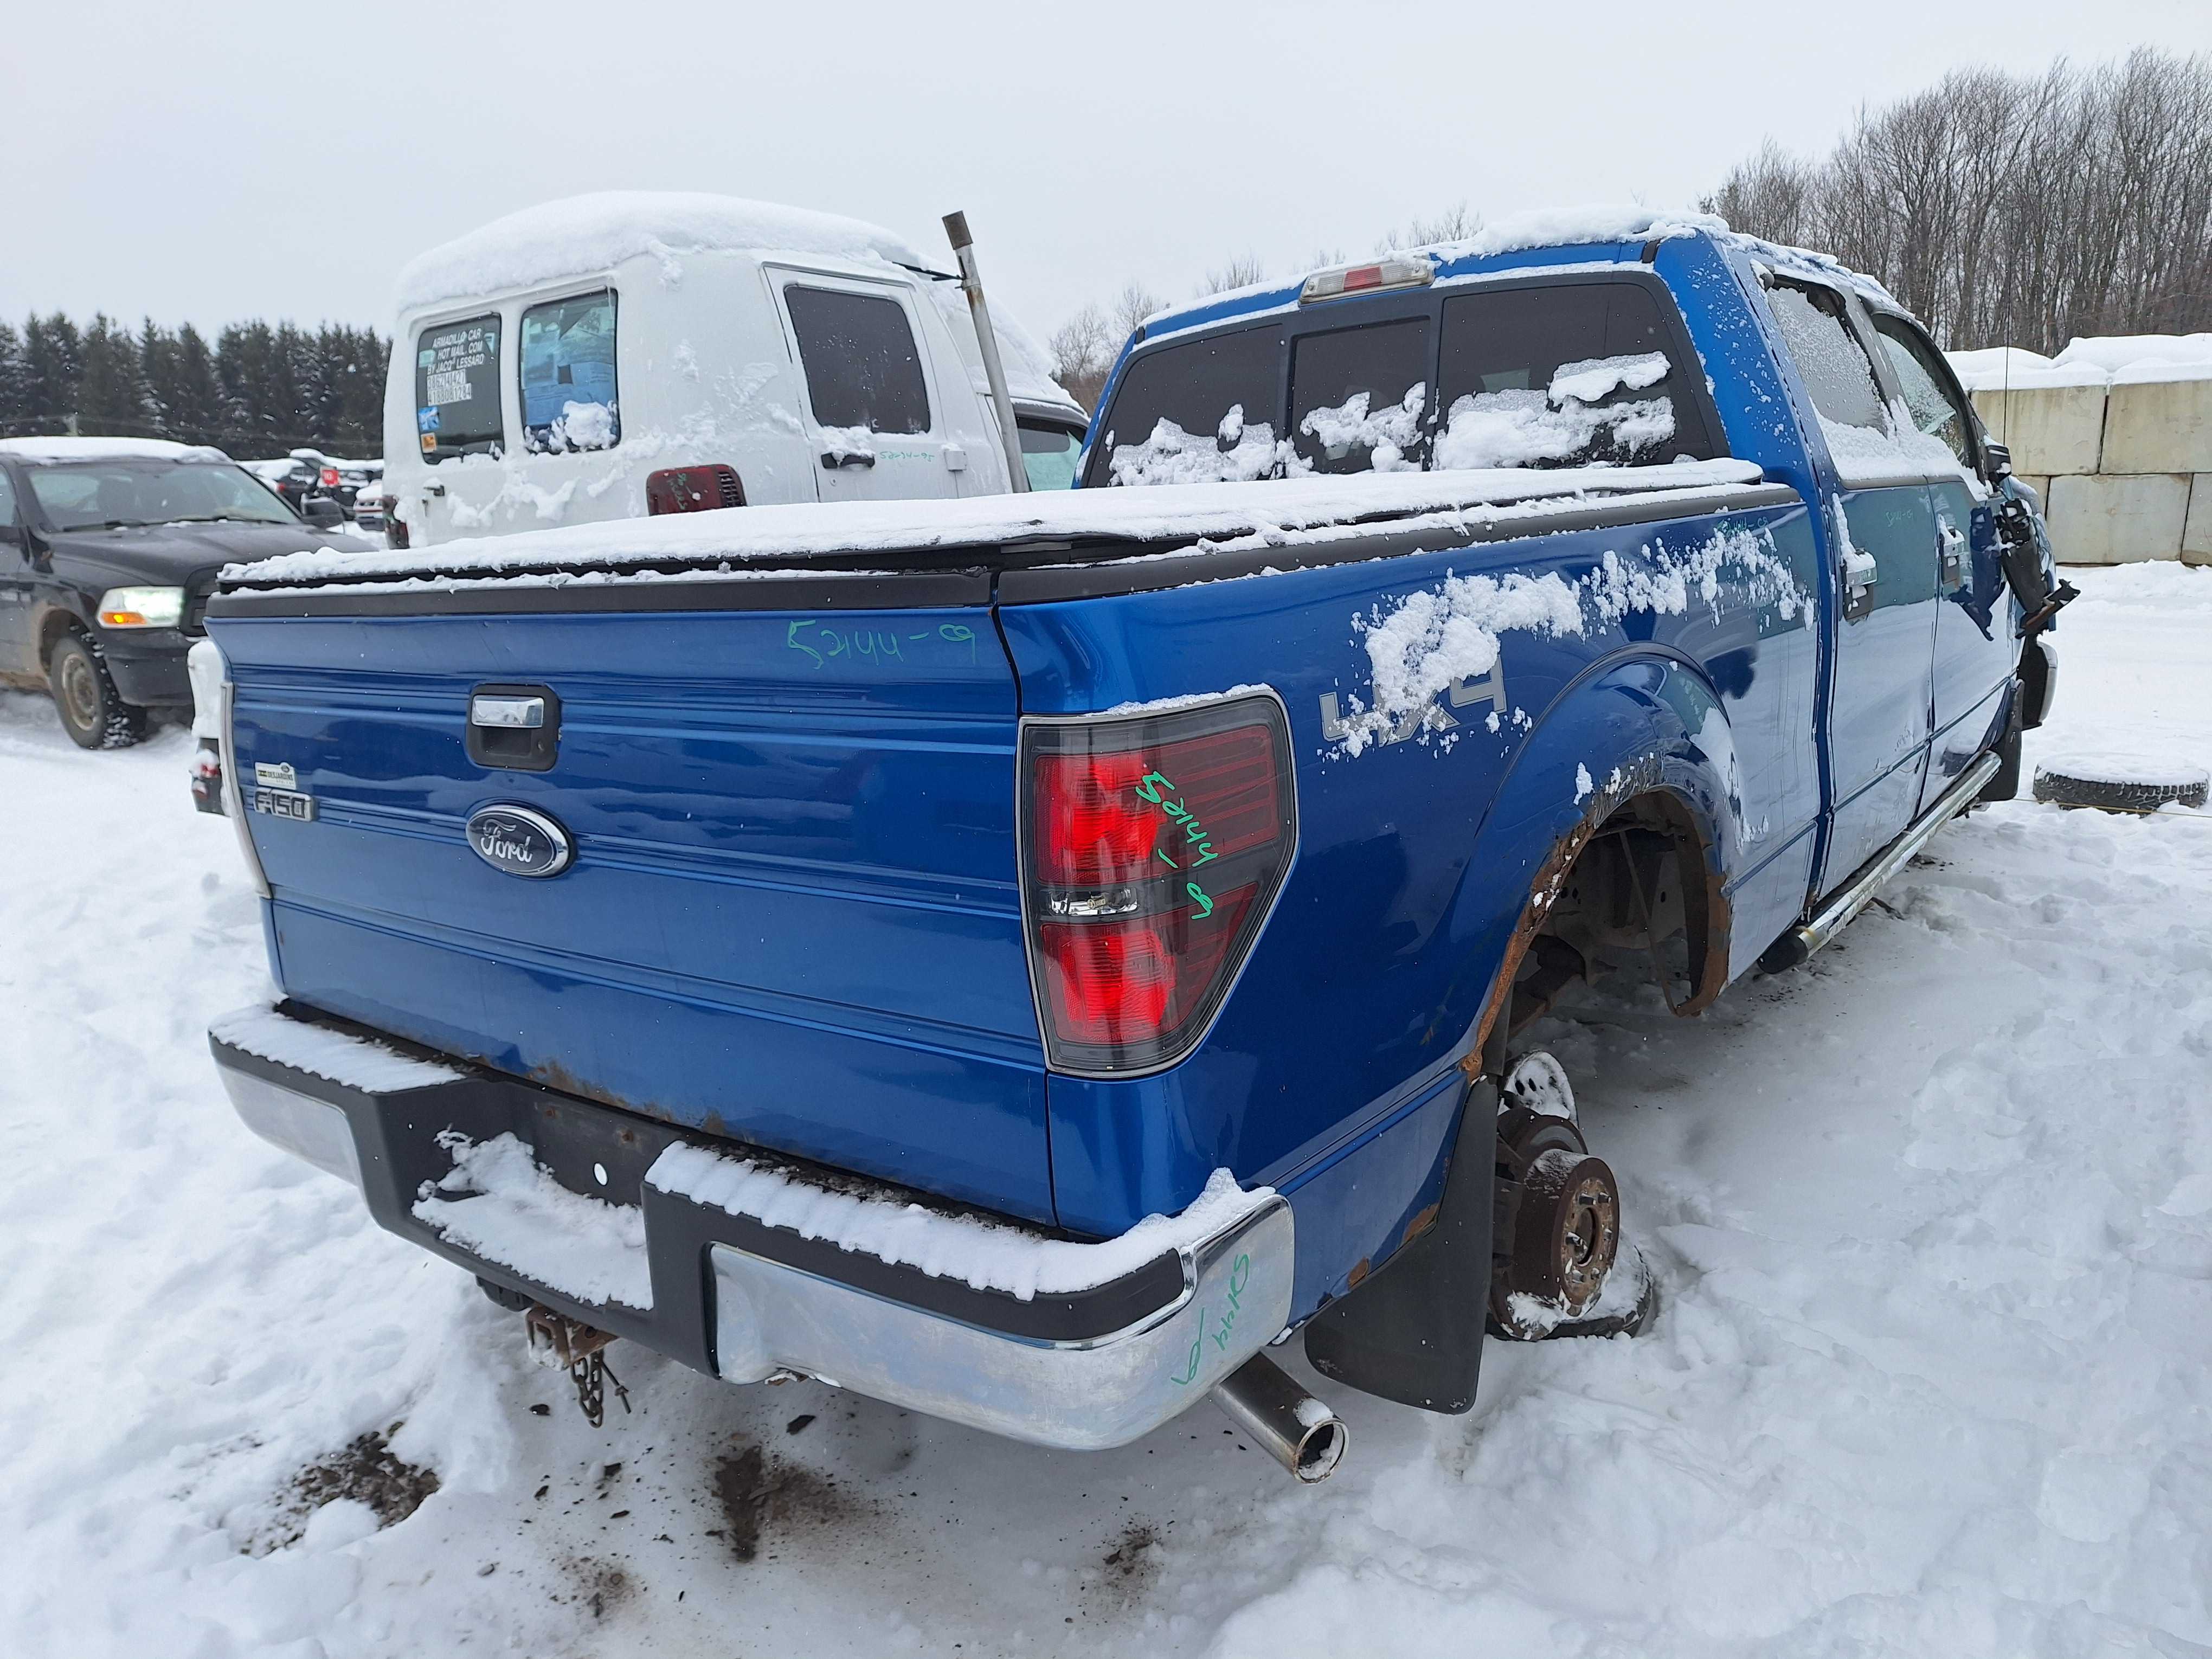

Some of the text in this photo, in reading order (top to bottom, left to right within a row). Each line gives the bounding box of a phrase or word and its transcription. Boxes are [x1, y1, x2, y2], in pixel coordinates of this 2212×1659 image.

[432, 327, 481, 348] ARMADILLO CAR
[438, 347, 451, 360] HOT
[468, 340, 483, 353] COM
[427, 363, 436, 375] BY
[456, 353, 484, 369] LESSARD
[480, 818, 533, 863] Ford
